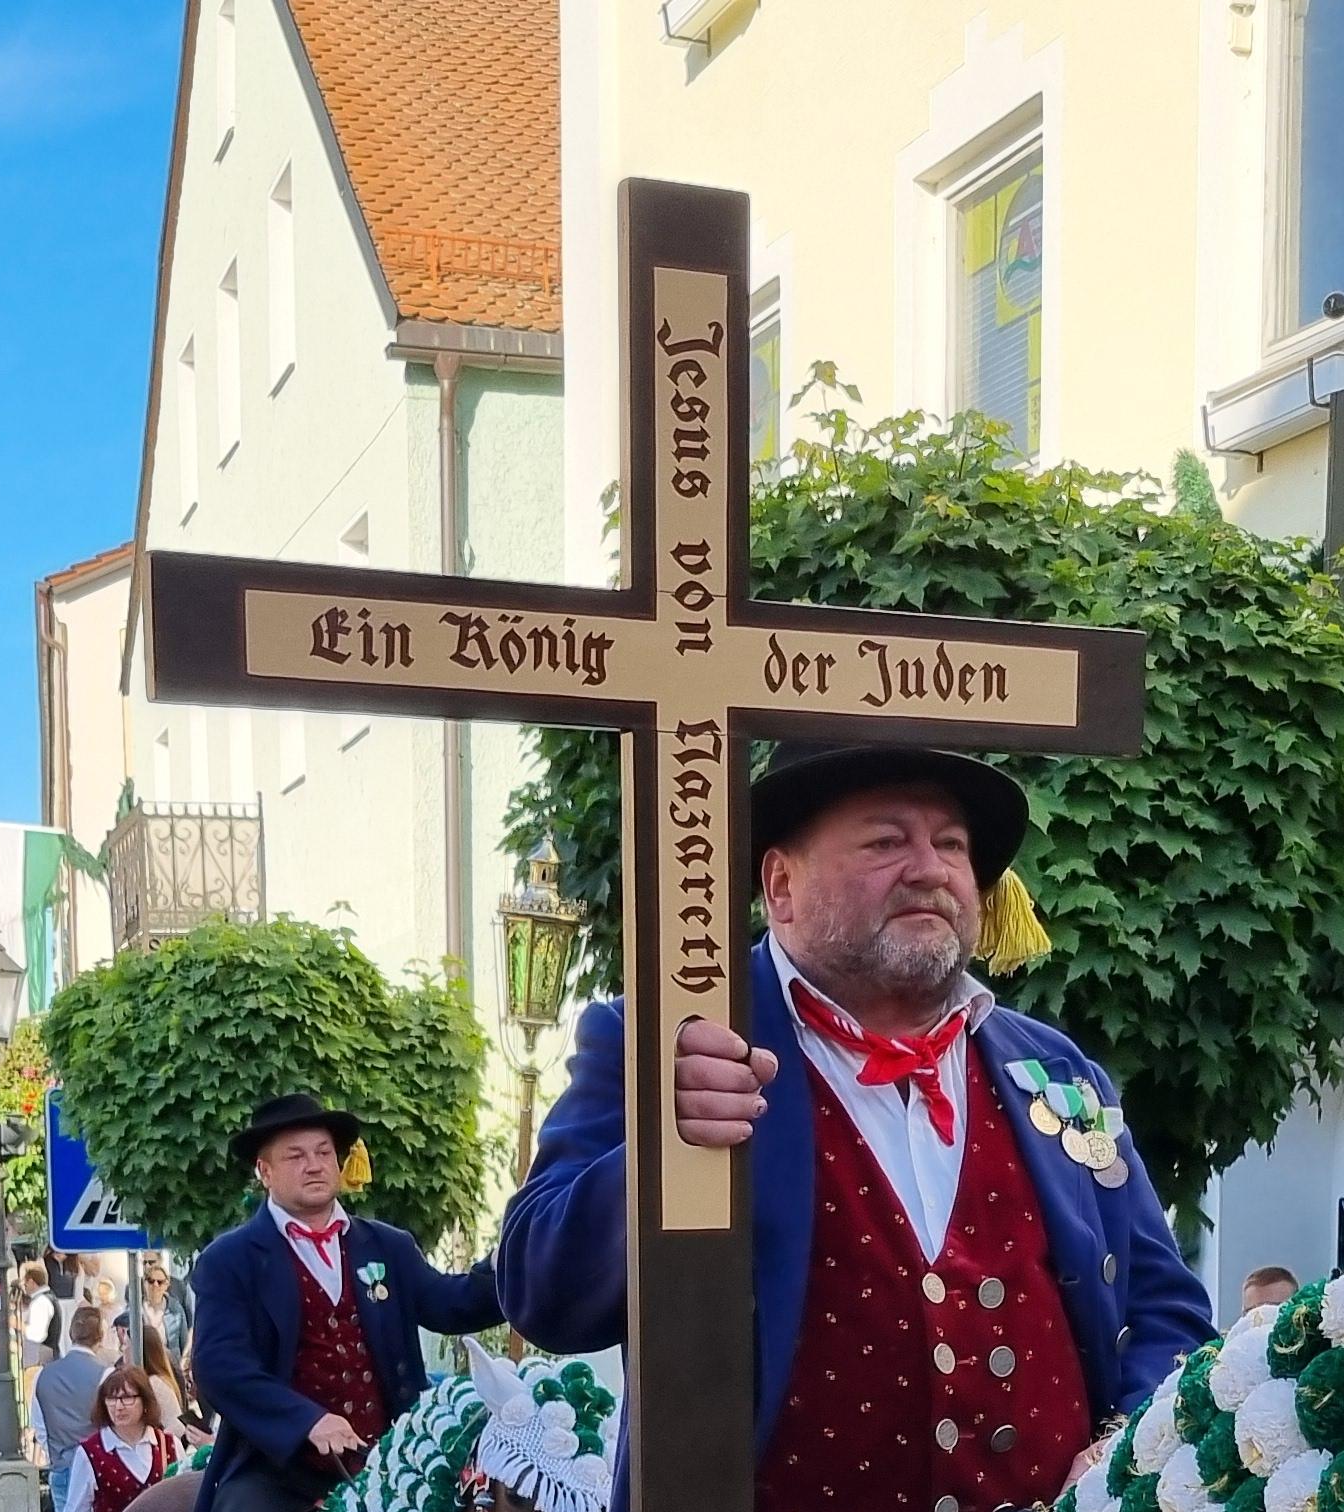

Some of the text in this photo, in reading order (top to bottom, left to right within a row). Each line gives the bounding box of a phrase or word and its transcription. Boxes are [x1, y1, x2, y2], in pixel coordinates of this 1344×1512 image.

[309, 606, 1009, 707] Ein König der Juden
[656, 317, 727, 994] Jesus von Nazareth
